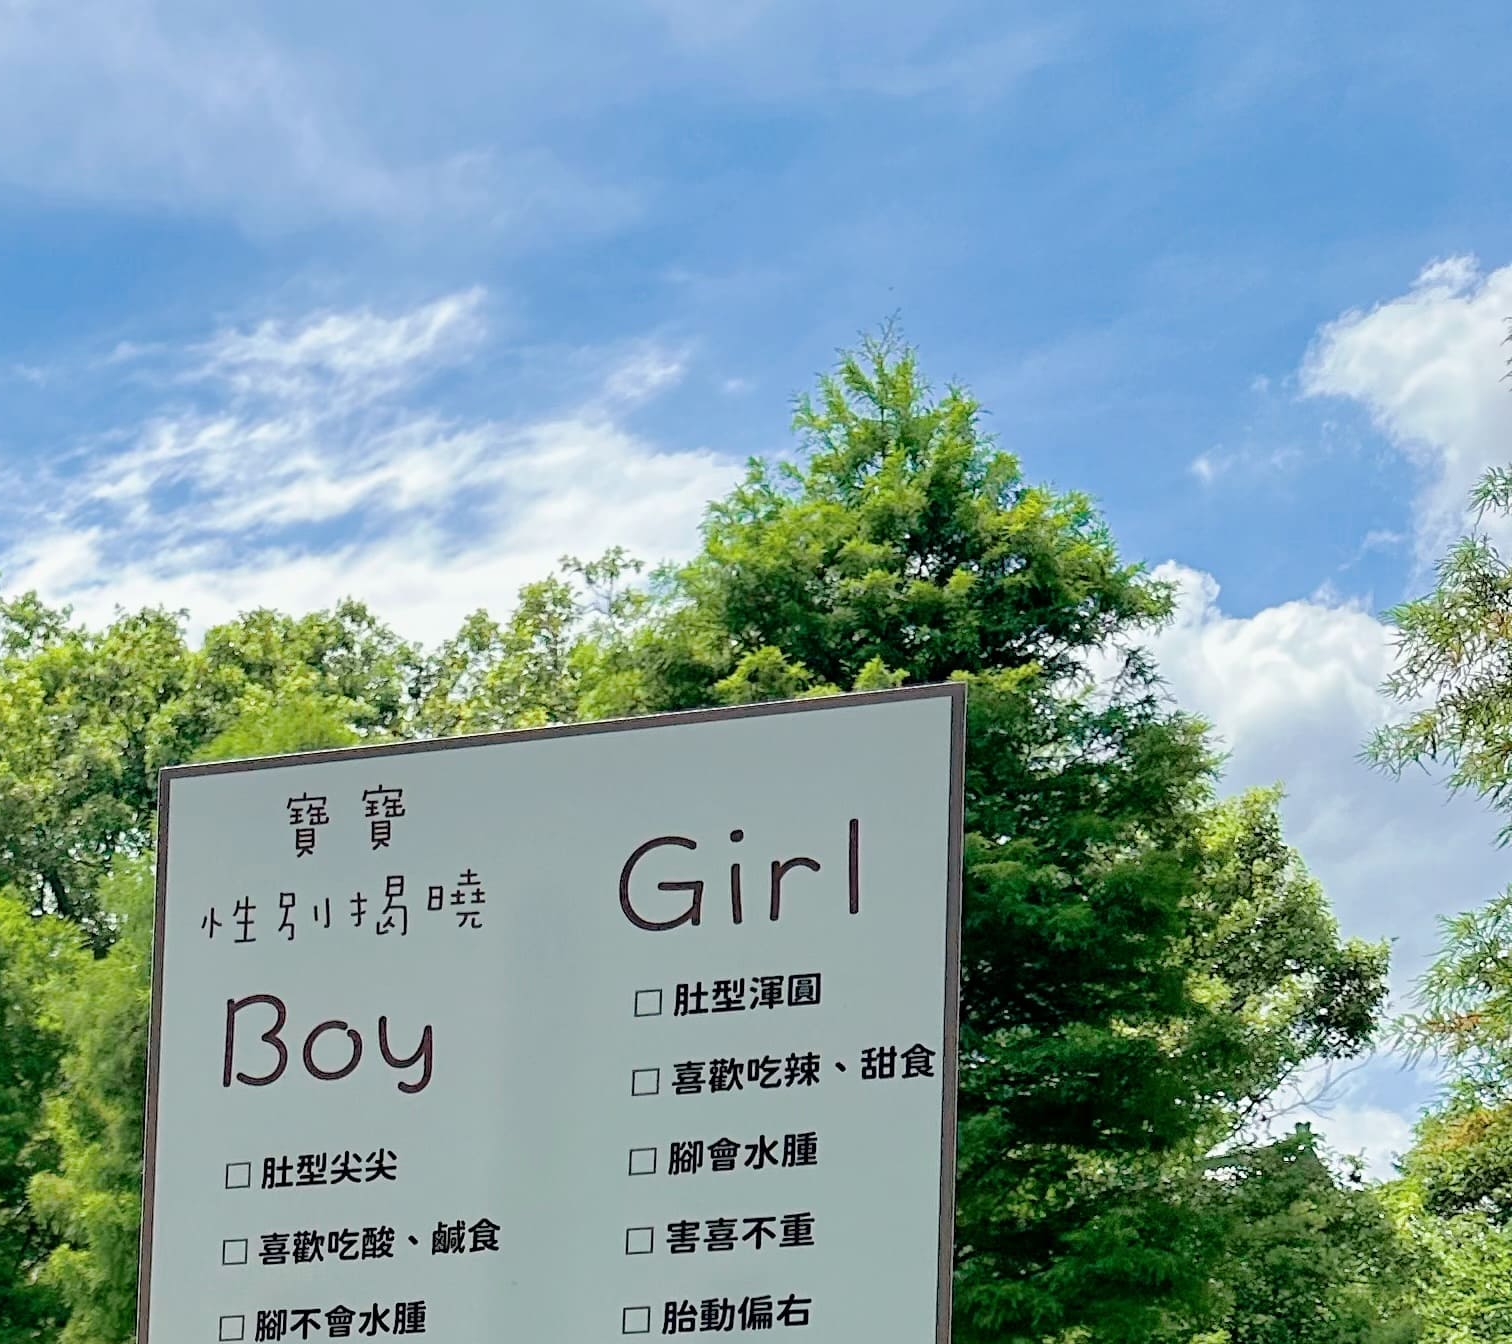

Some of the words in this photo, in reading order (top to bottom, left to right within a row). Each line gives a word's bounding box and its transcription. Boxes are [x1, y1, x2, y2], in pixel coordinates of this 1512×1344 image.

[619, 818, 859, 931] Girl
[674, 973, 821, 1016] 肚型渾圓
[223, 994, 432, 1094] Boy
[672, 1044, 936, 1095] 喜歡吃辣、甜食
[262, 1148, 397, 1189] 肚型尖尖
[668, 1132, 817, 1175] 腳會水腫
[259, 1218, 500, 1265] 喜歡吃酸、鹹食
[666, 1212, 815, 1254] 害喜不重
[255, 1301, 426, 1342] 腳不會水腫
[662, 1294, 812, 1334] 胎動偏右
